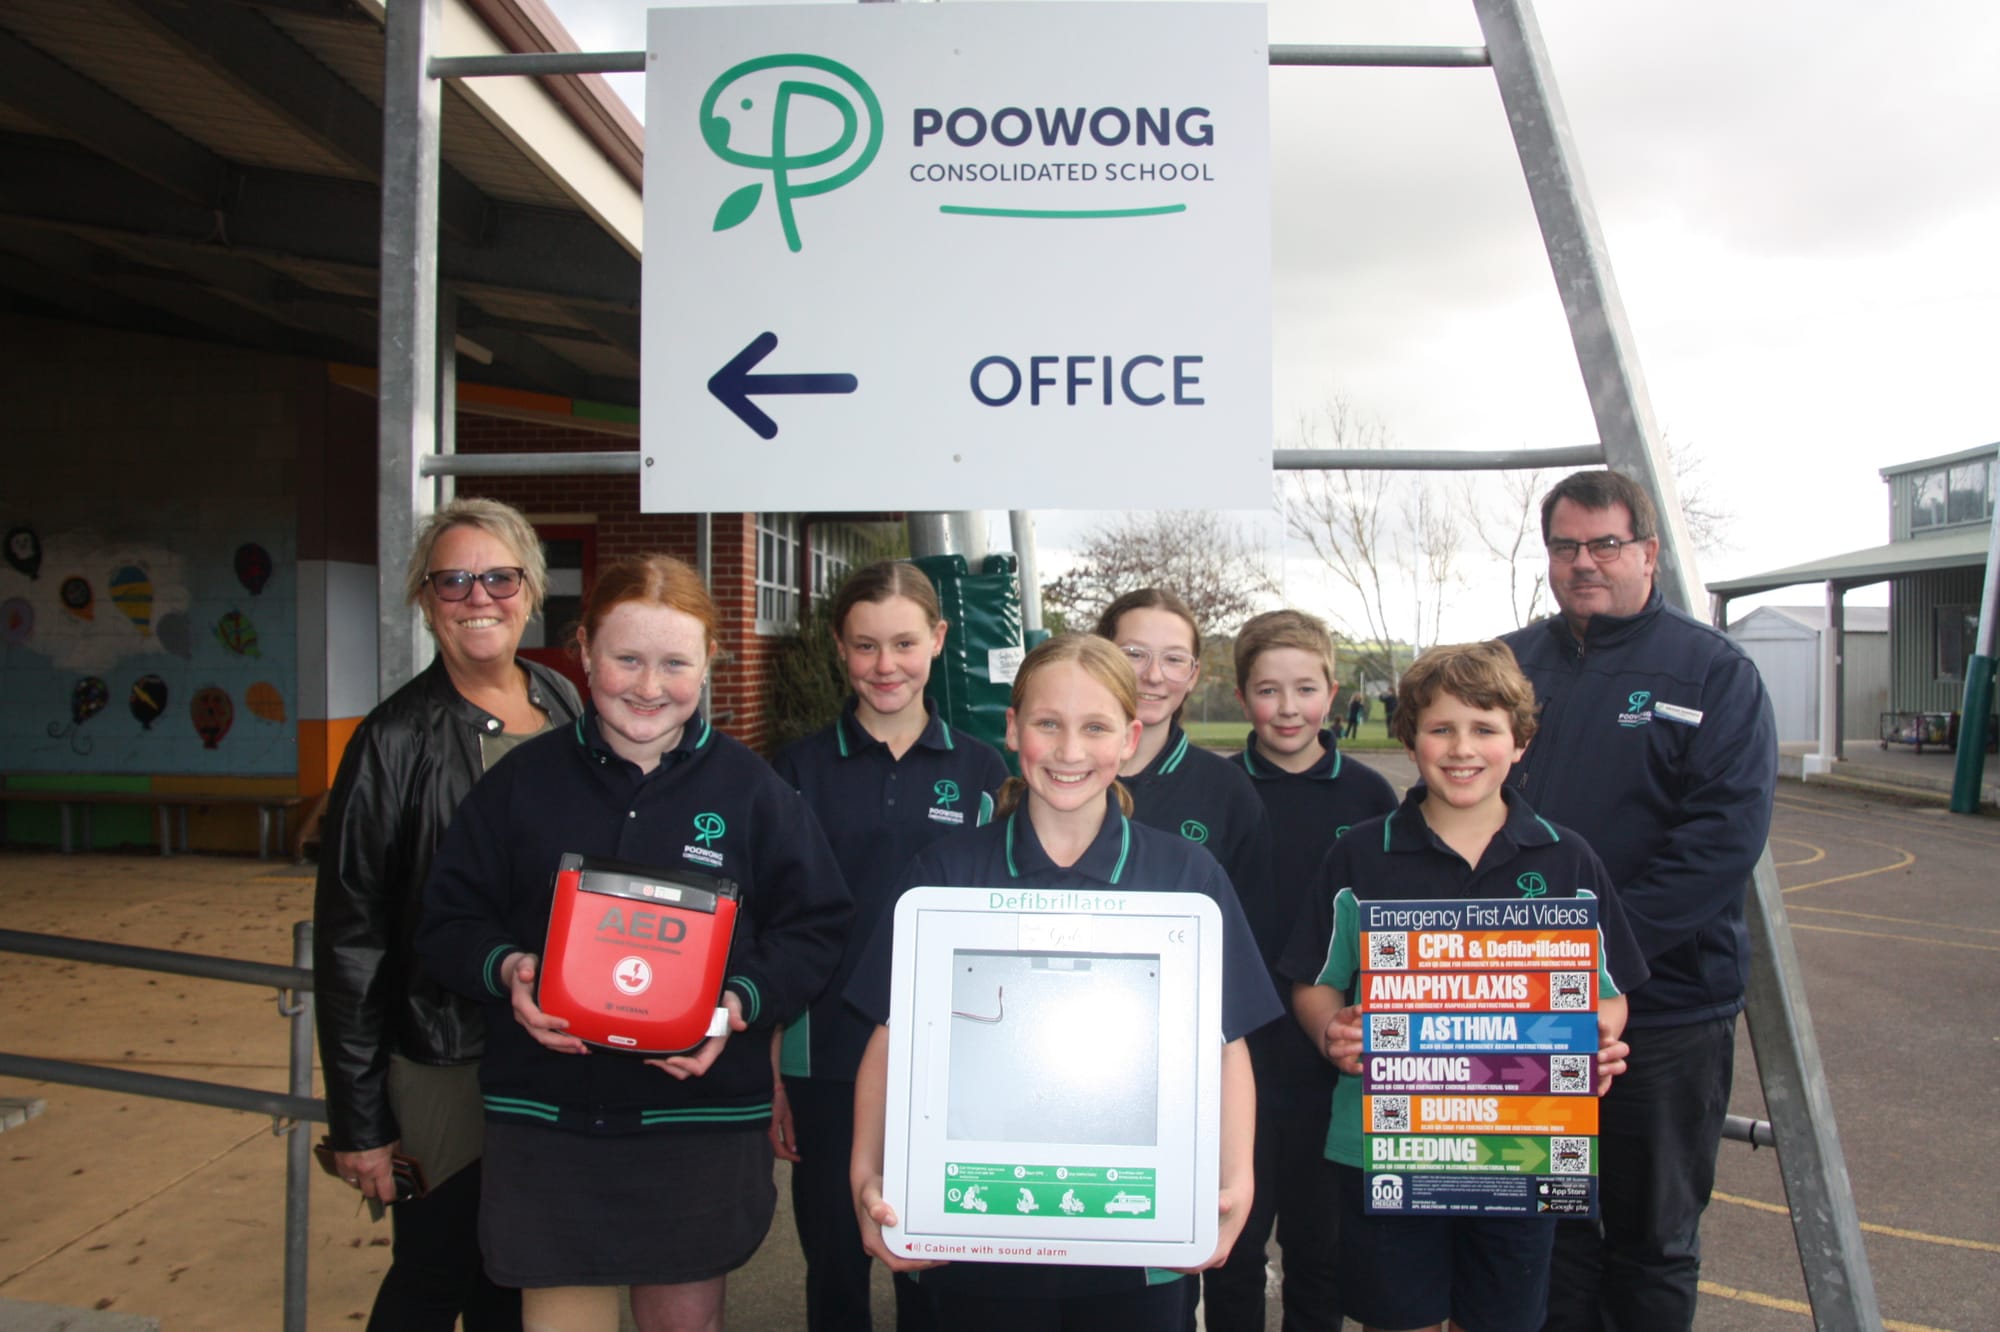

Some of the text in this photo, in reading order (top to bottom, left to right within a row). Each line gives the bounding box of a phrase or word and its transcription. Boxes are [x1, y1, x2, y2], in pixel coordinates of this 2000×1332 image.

[912, 106, 1214, 147] POOWONG
[910, 162, 1214, 182] CONSOLIDATED SCHOOL
[969, 354, 1205, 407] OFFICE
[989, 892, 1127, 911] Defibrillator
[597, 906, 687, 943] AED
[1370, 904, 1588, 931] Emergency First Aid Videos
[1418, 933, 1464, 959] CPR
[1469, 940, 1483, 959] &
[1487, 939, 1590, 958] Defibrillation
[1370, 974, 1528, 1000] ANAPHYLAXIS
[1420, 1016, 1518, 1041] ASTHMA
[1371, 1057, 1470, 1082] CHOKING
[1420, 1097, 1499, 1122] BURNS
[1372, 1137, 1477, 1162] BLEEDING
[1372, 1185, 1403, 1200] 000
[1552, 1188, 1566, 1196] App
[1550, 1203, 1589, 1213] Google play
[925, 1243, 1067, 1257] Cabinet with sound alarm
